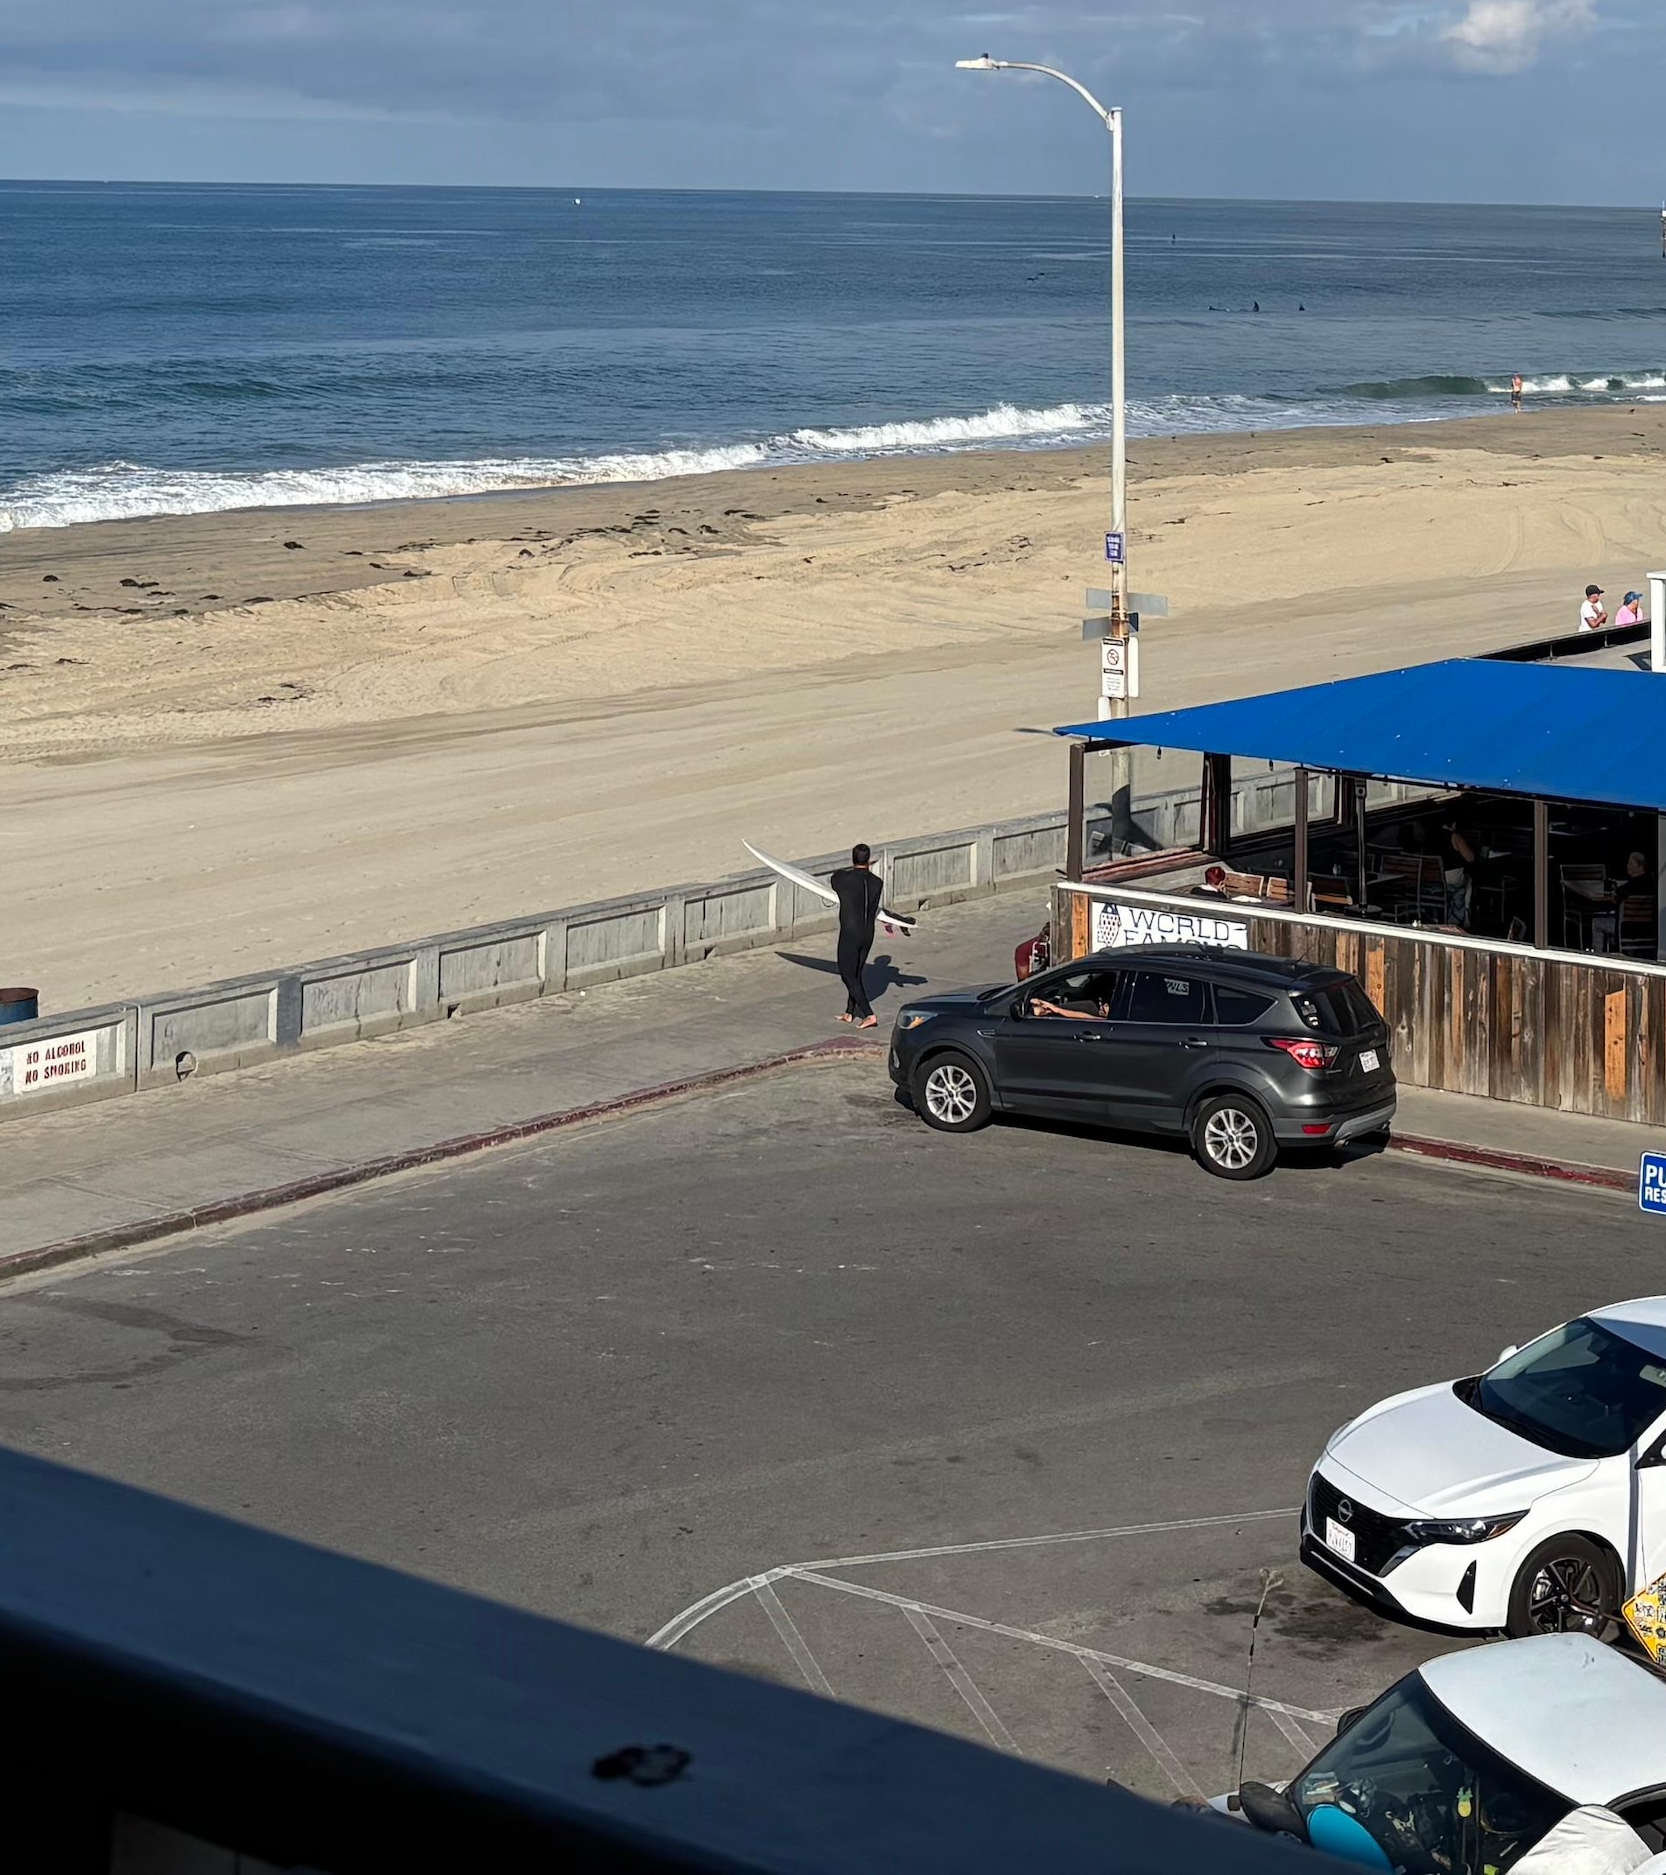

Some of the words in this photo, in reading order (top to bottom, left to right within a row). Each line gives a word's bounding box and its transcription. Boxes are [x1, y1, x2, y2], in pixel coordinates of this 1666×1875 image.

[1128, 908, 1230, 941] WORLD
[26, 1050, 40, 1065] NO
[45, 1040, 86, 1061] ALCOHOL
[25, 1068, 38, 1085] NO
[44, 1059, 86, 1080] SMOKING
